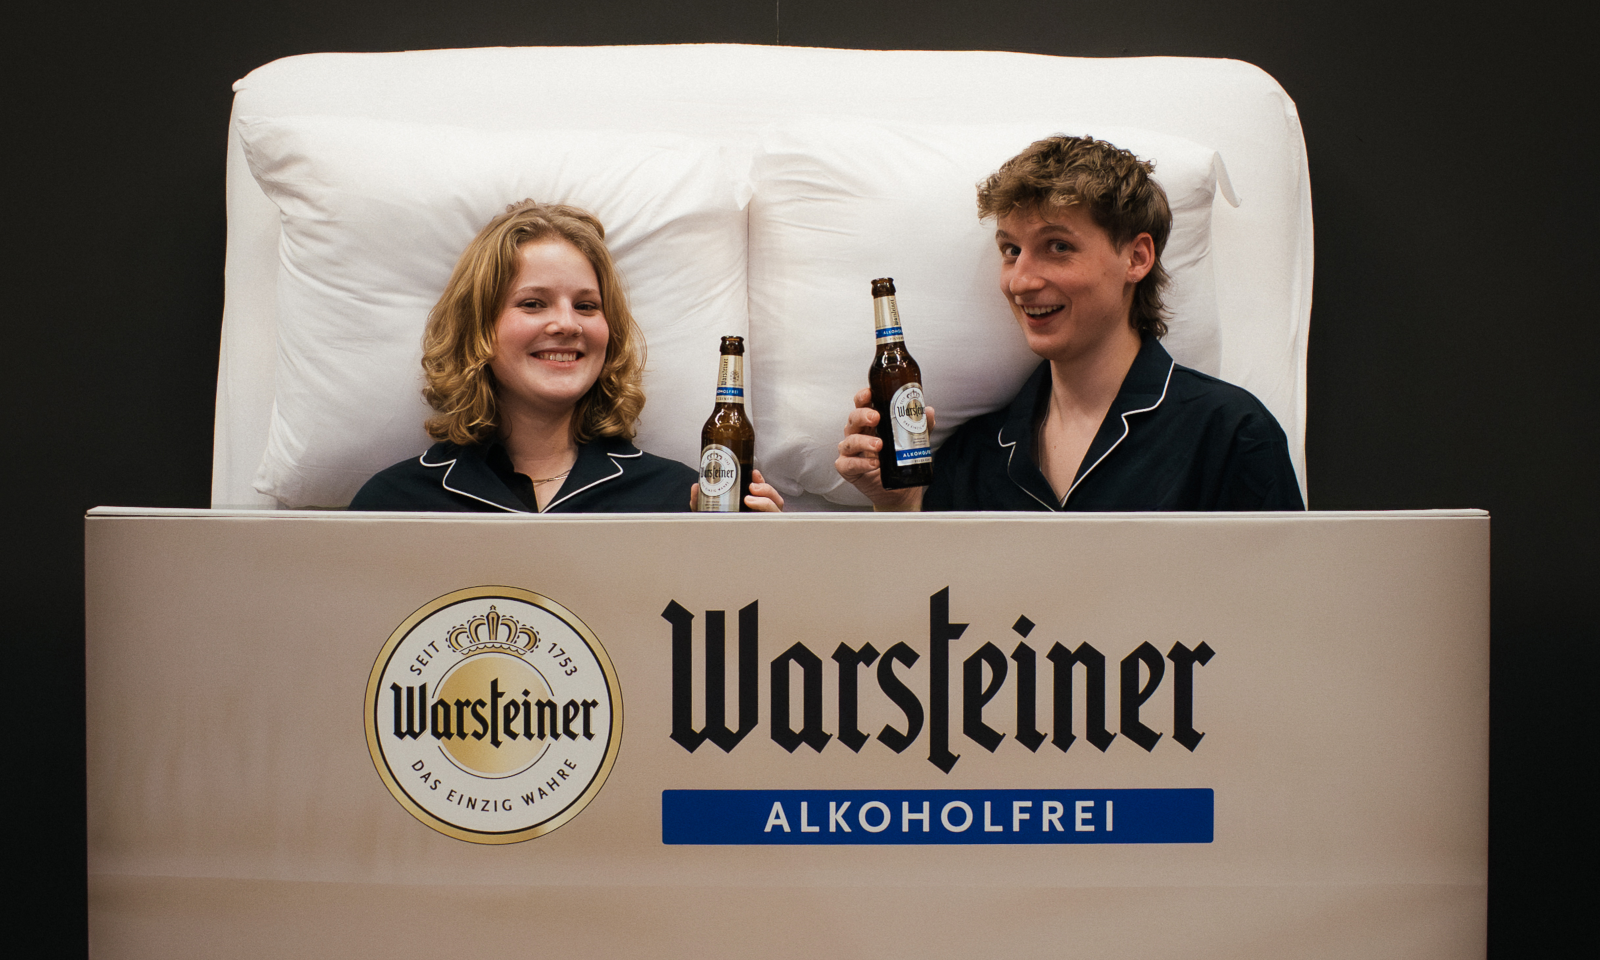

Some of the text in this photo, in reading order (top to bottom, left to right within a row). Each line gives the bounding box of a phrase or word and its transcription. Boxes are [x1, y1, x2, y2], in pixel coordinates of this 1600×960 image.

[409, 640, 440, 676] SEIT
[547, 642, 578, 677] 1753
[660, 585, 1216, 775] Warsteiner
[390, 677, 599, 749] Warsteiner
[411, 758, 577, 813] DAS EINZIG WAHRE
[763, 800, 1114, 833] ALKOHOLFREI
